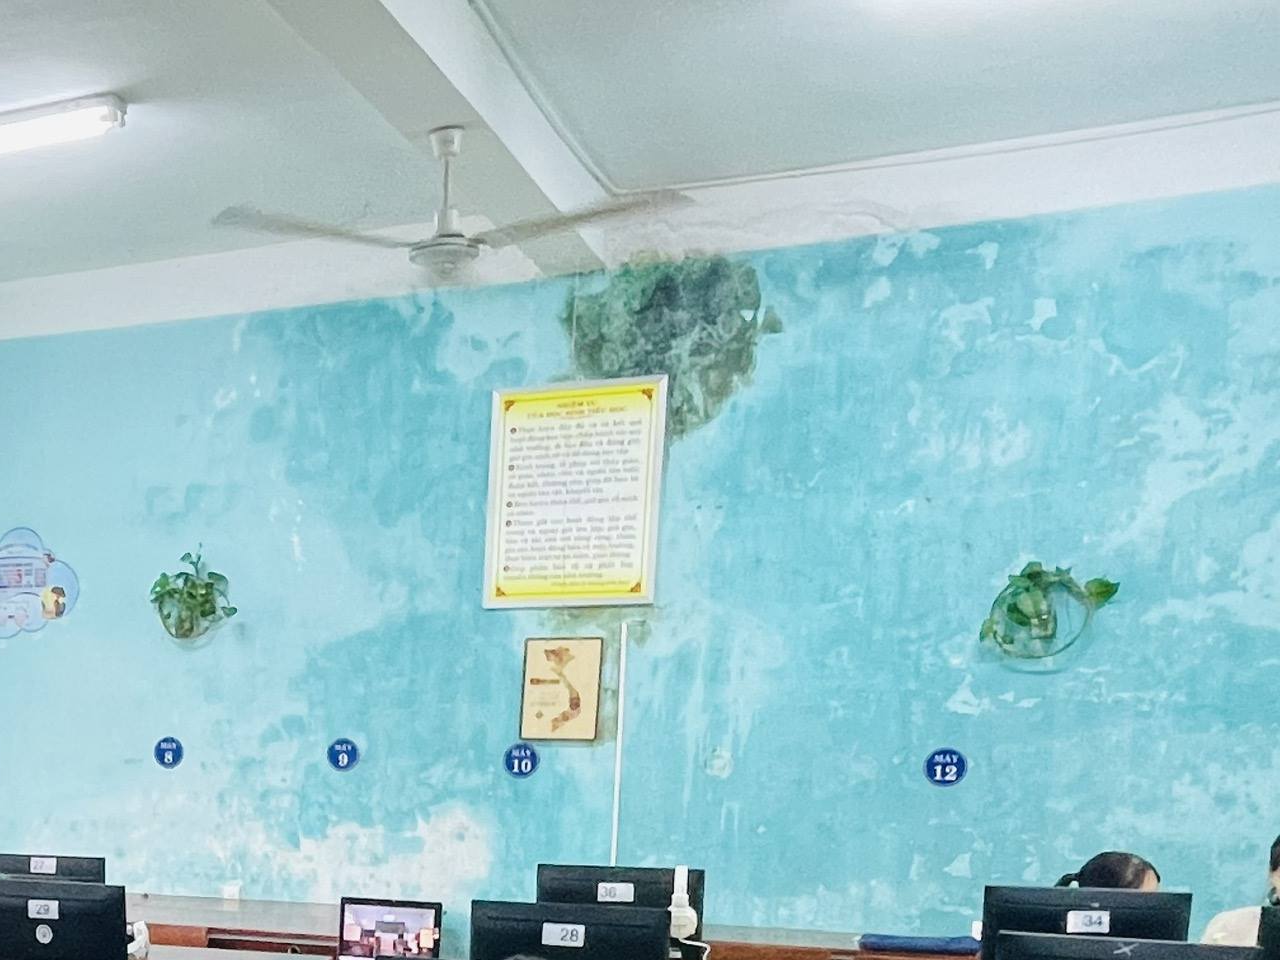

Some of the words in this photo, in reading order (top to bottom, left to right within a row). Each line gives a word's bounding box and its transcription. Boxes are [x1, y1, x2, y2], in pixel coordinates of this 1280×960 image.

[164, 750, 173, 764] 8
[338, 752, 348, 766] 9
[512, 759, 532, 773] 10
[934, 765, 957, 780] 12
[36, 904, 50, 915] 29
[1082, 914, 1103, 927] 34
[560, 928, 579, 942] 28
